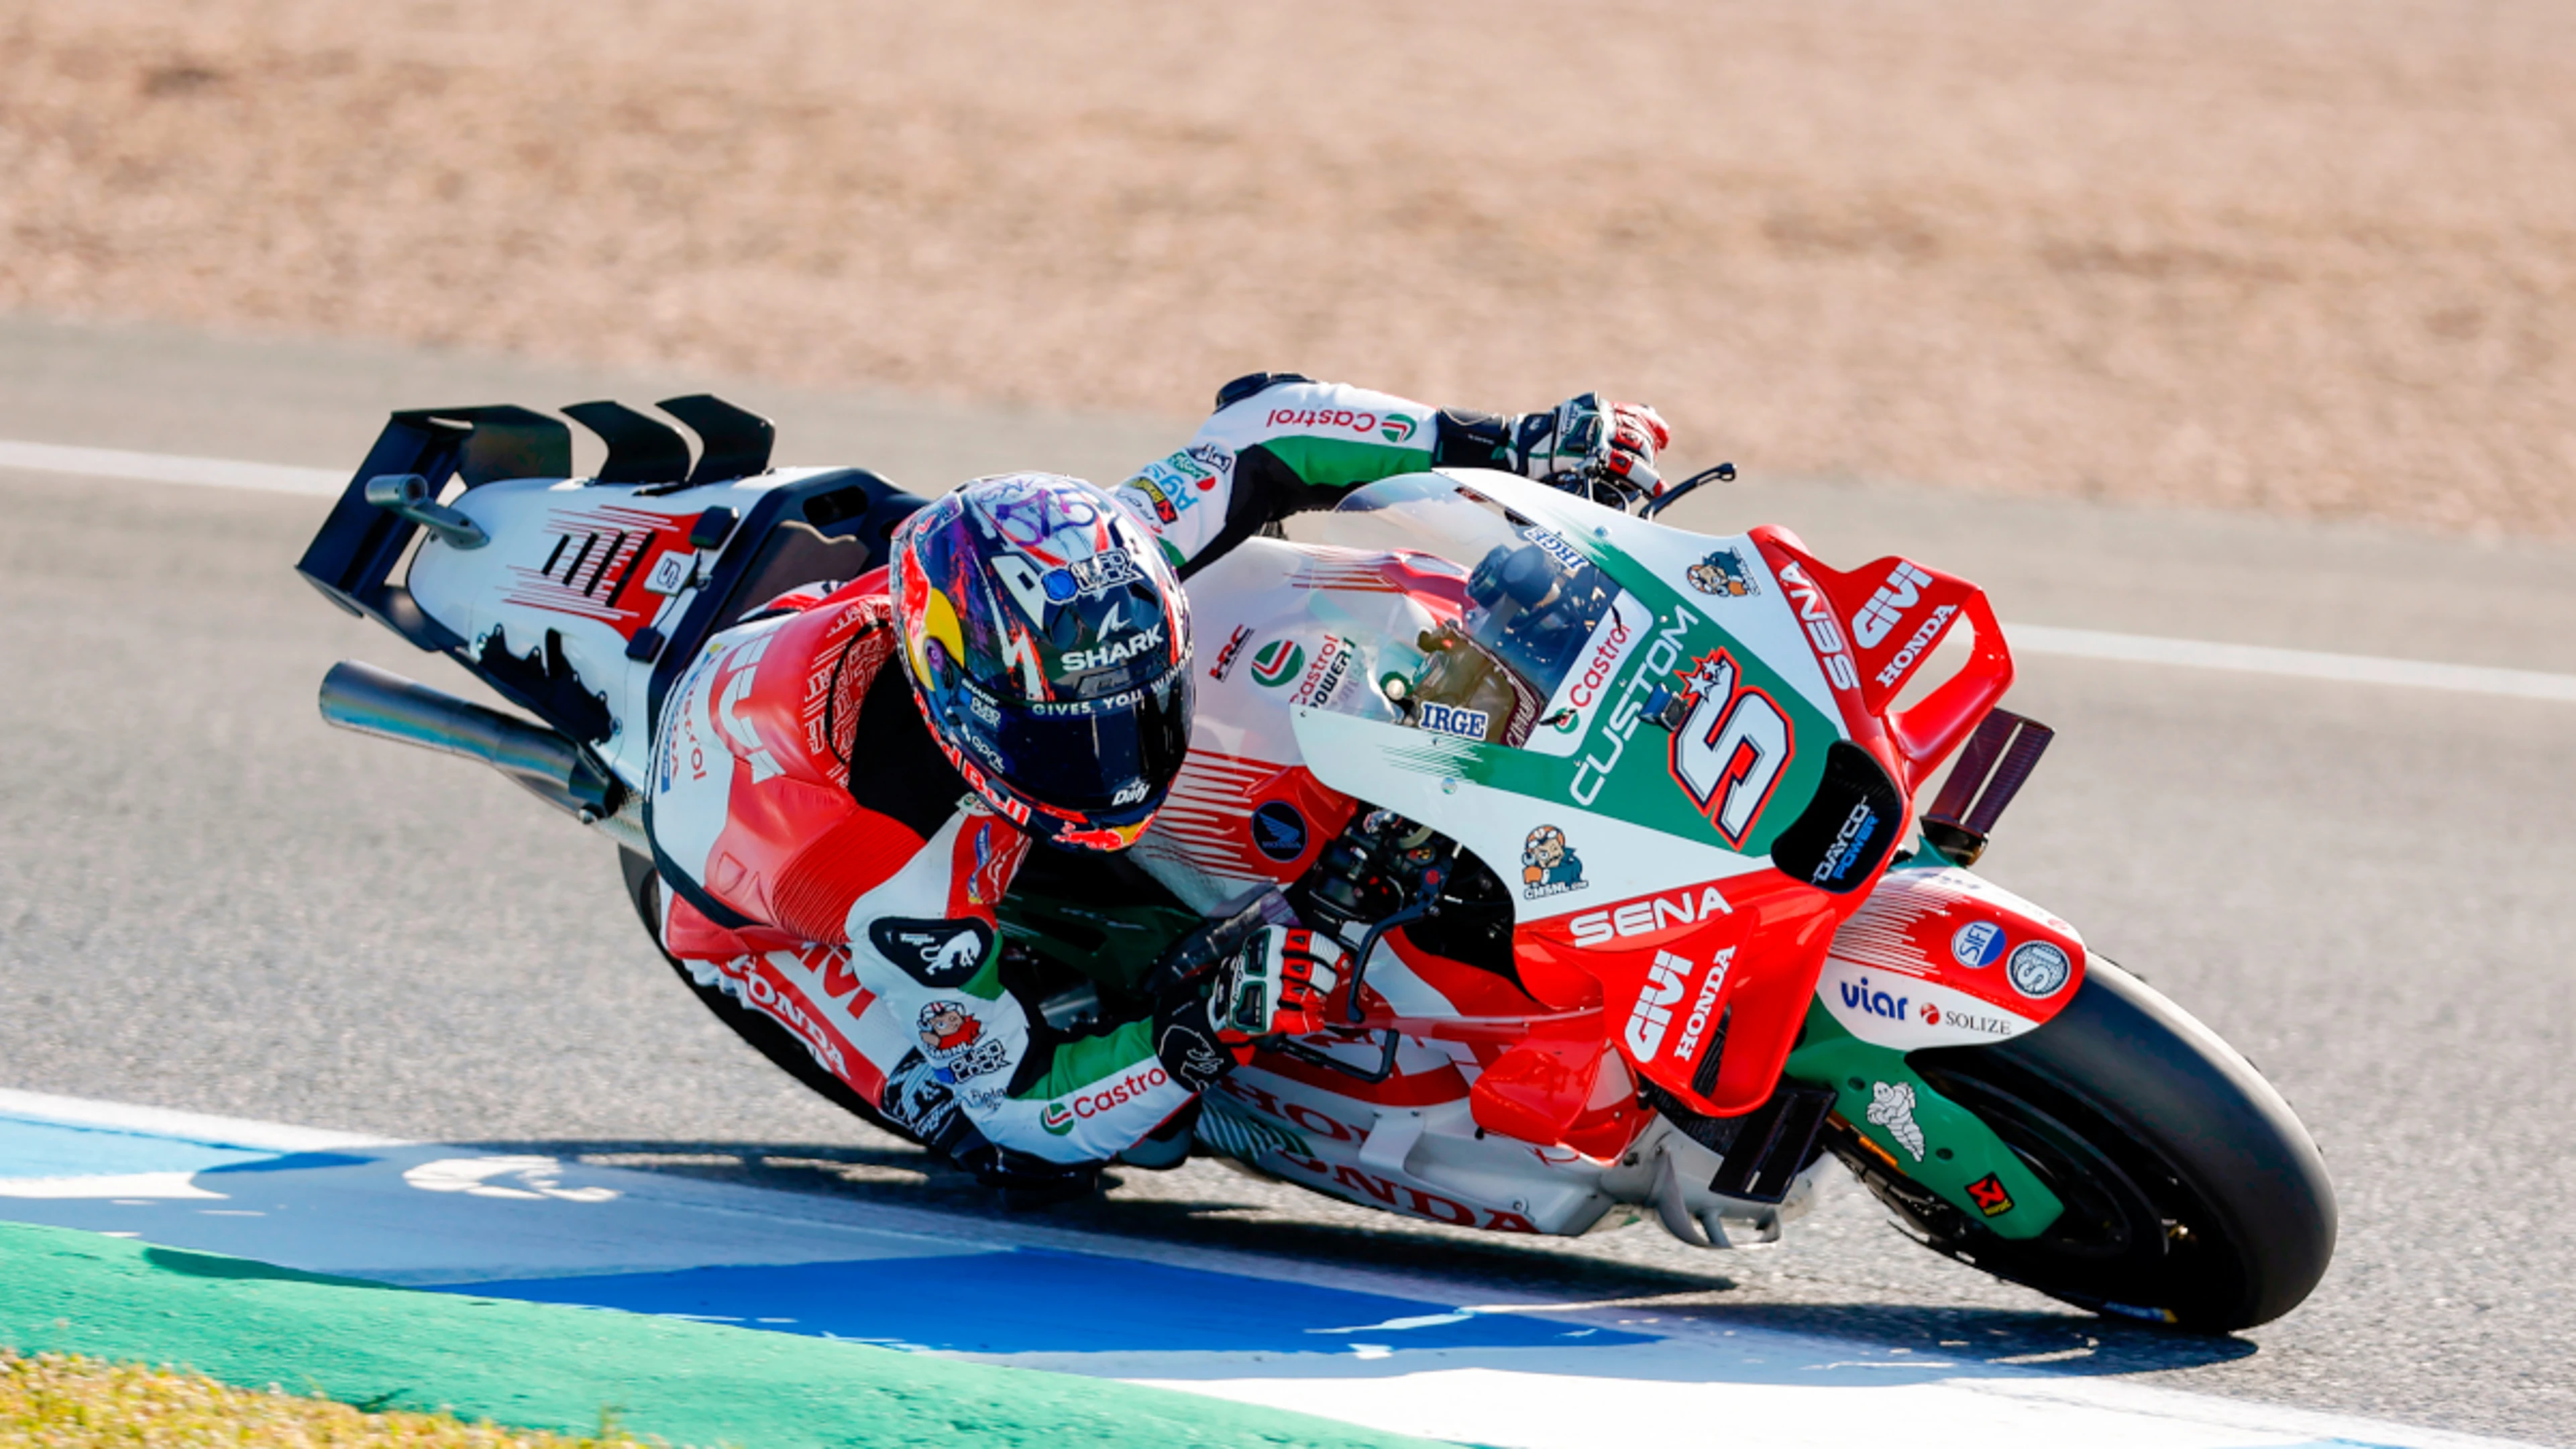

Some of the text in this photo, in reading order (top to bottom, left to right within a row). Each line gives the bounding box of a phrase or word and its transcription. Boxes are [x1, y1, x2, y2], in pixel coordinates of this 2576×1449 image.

[1267, 409, 1376, 432] Castrol
[1779, 560, 1860, 690] SENA
[1851, 561, 1934, 649] GIVI
[1061, 623, 1164, 670] SHARK
[1876, 604, 1957, 688] HONDA
[1032, 702, 1091, 716] GIVES
[1104, 689, 1143, 709] YOU
[1421, 705, 1486, 738] IRGE
[1570, 605, 1699, 806] CUSTOM
[961, 759, 1031, 827] Bull
[1813, 803, 1870, 881] DAYCO
[1832, 815, 1879, 879] POWER
[1569, 887, 1733, 948] SENA
[1960, 924, 1992, 961] SIFI
[1625, 949, 1694, 1063] GIVI
[1674, 945, 1737, 1062] HONDA
[1840, 976, 1908, 1021] viar
[1946, 1010, 2012, 1035] SOLIZE
[1073, 1067, 1167, 1119] Castro
